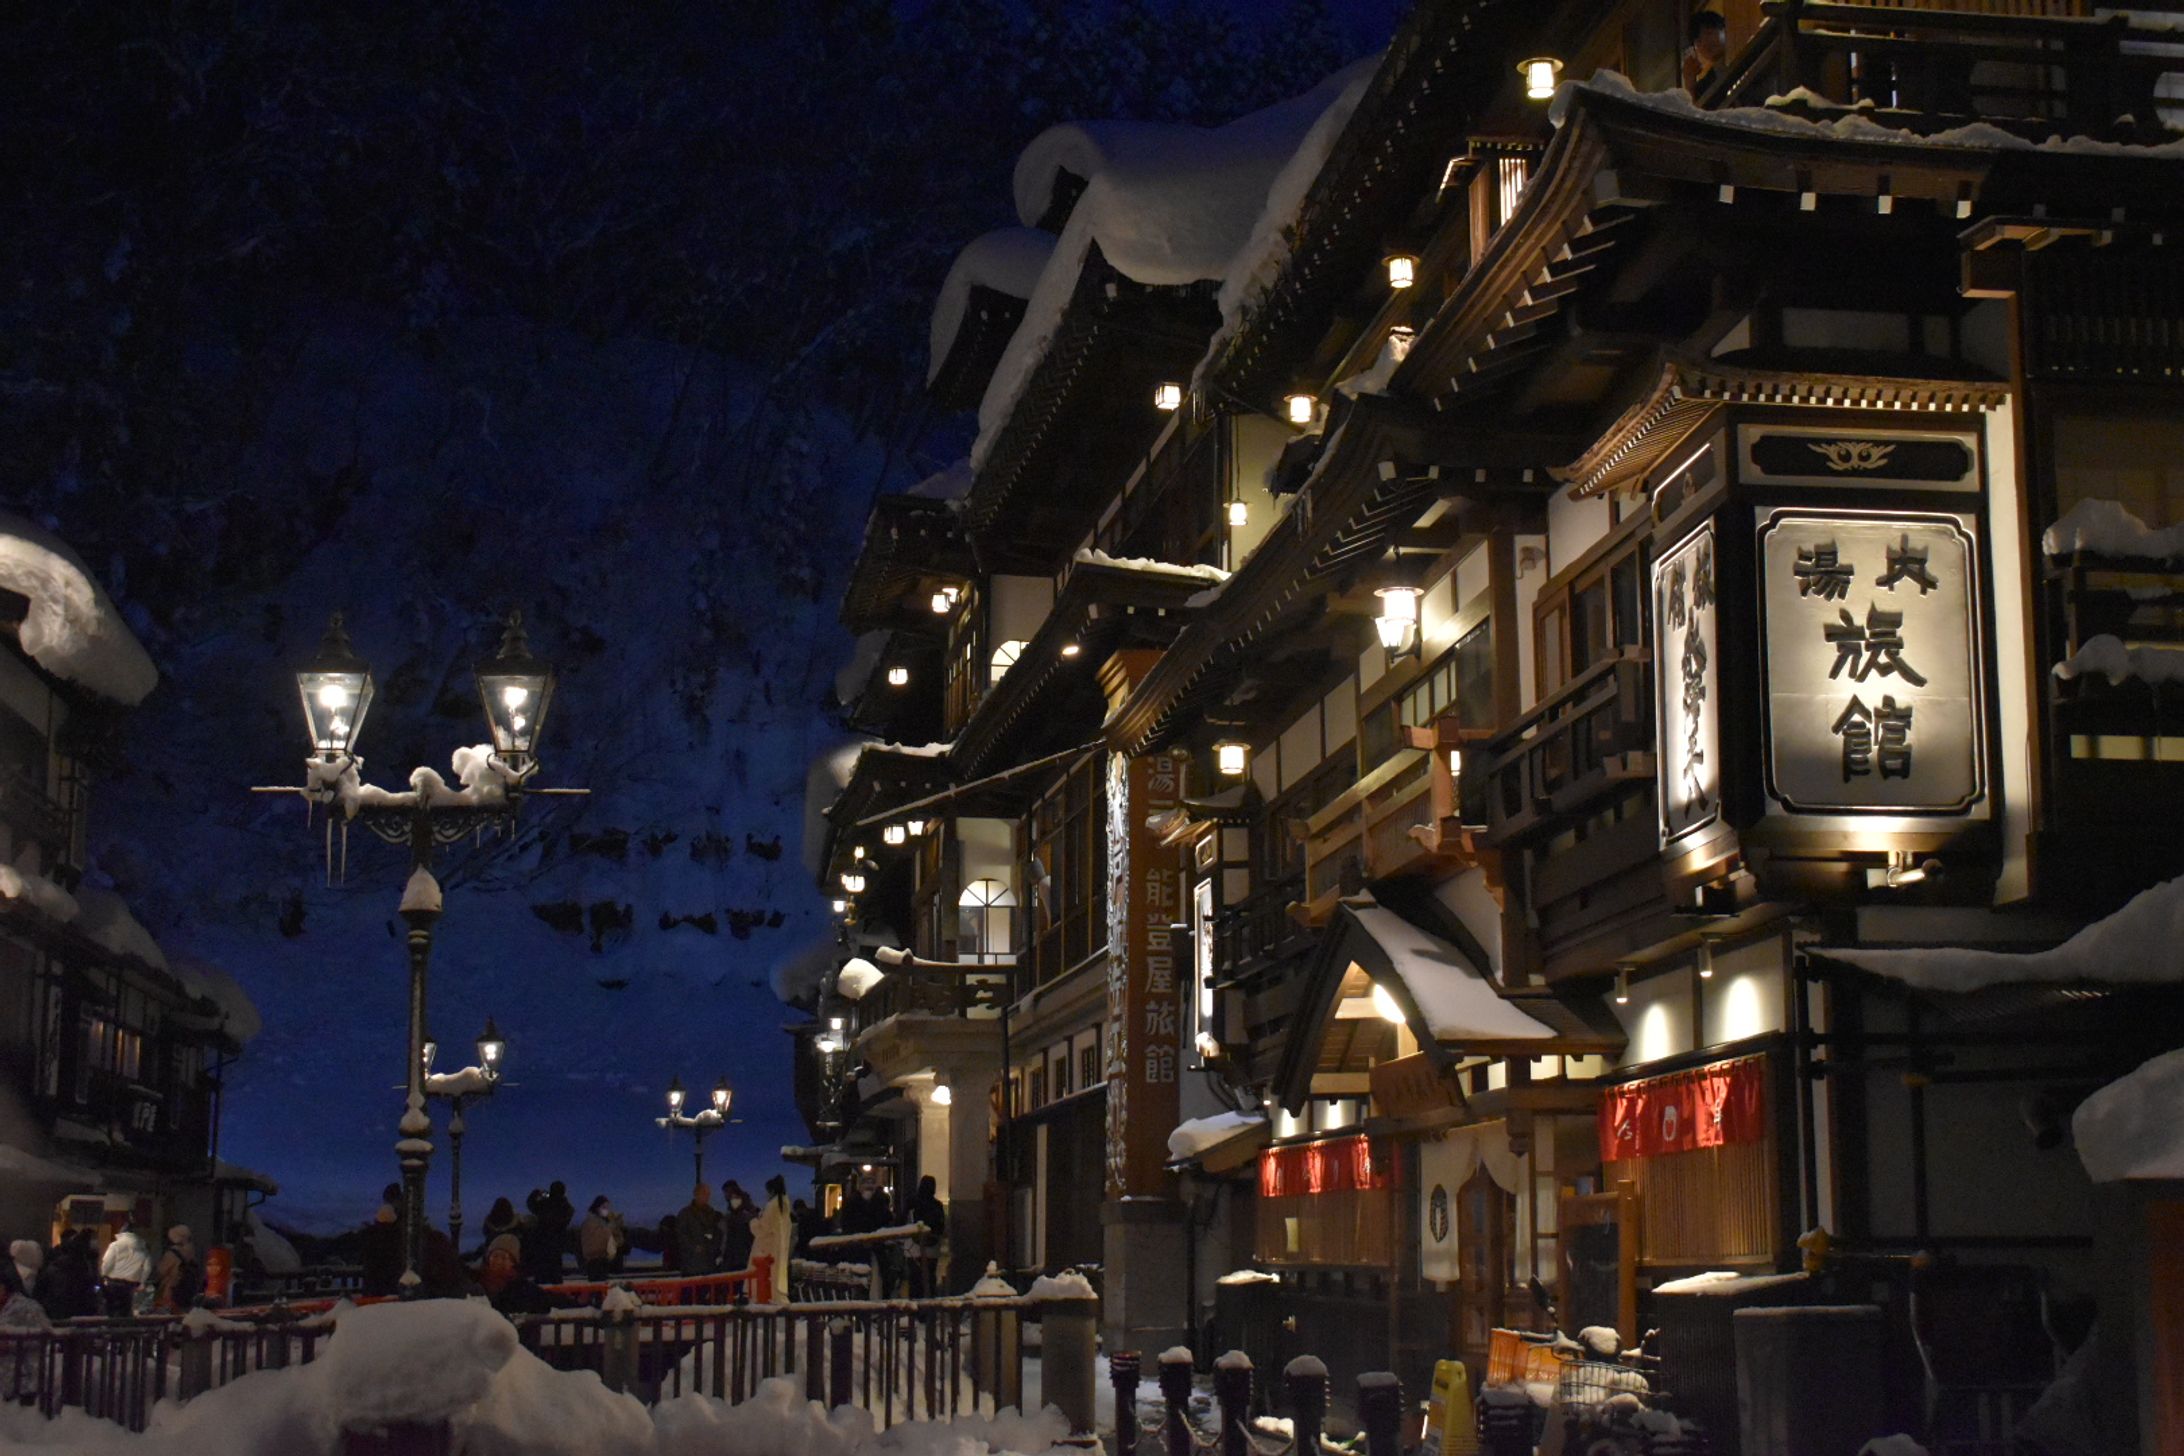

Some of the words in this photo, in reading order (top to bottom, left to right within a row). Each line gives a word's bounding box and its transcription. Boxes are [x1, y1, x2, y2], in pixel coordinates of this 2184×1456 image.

[1823, 600, 1928, 784] 旅館
[1145, 868, 1175, 1083] 能登屋旅館
